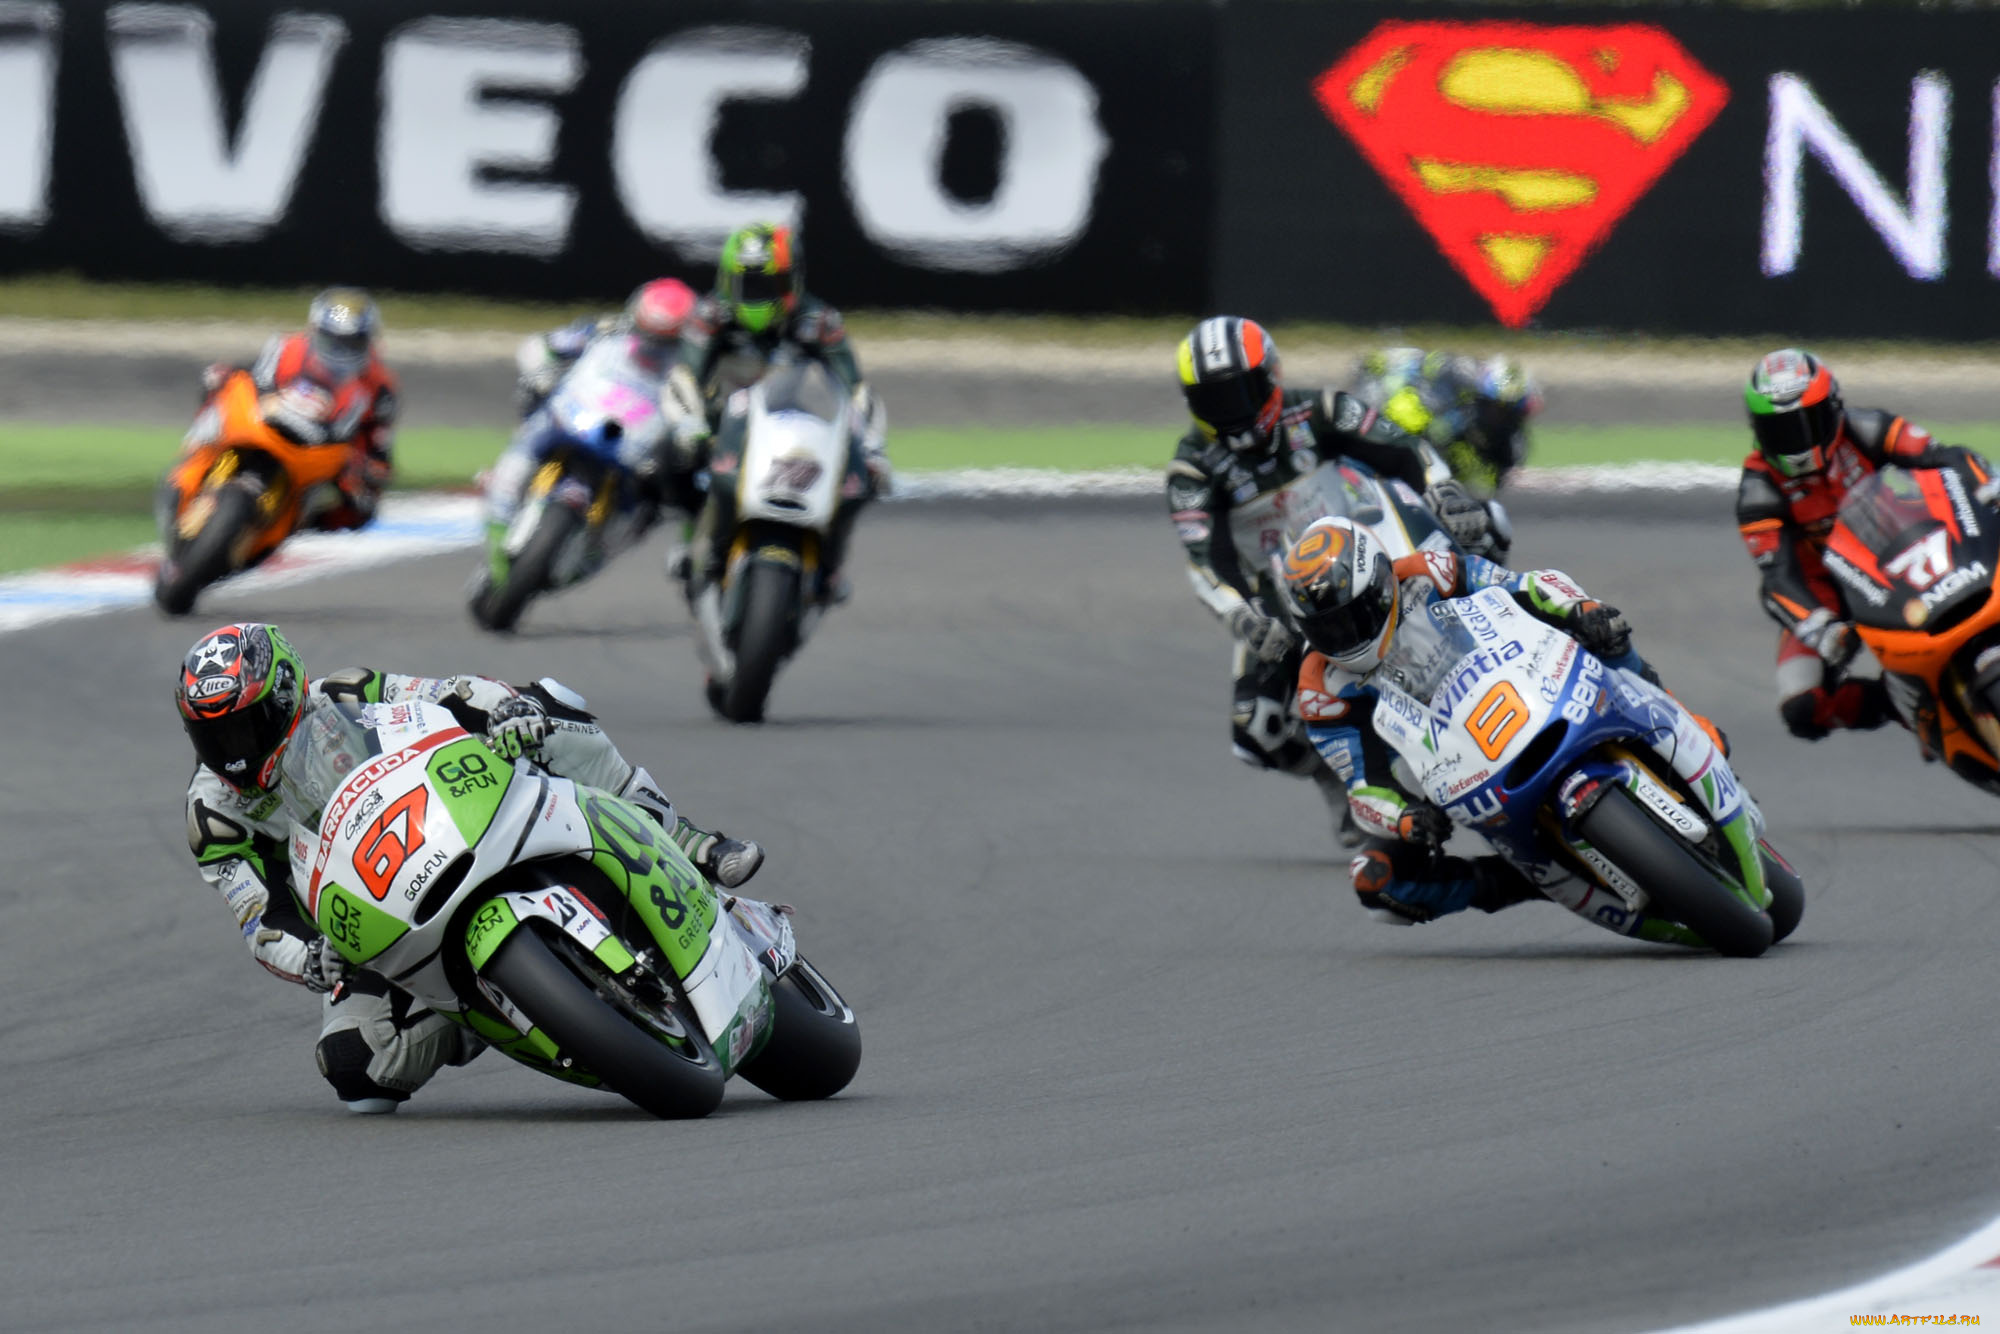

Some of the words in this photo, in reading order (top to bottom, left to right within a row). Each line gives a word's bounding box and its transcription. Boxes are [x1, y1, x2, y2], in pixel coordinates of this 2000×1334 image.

[1920, 560, 1989, 611] NGM
[1429, 639, 1524, 752] Avintia
[1464, 680, 1530, 762] 8
[436, 753, 488, 784] GO
[448, 772, 499, 798] &FUN
[315, 748, 421, 874] BARRACUDA
[352, 782, 430, 903] 67
[404, 850, 449, 902] GO&FUN
[330, 893, 349, 943] GO
[348, 906, 363, 953] &FUN
